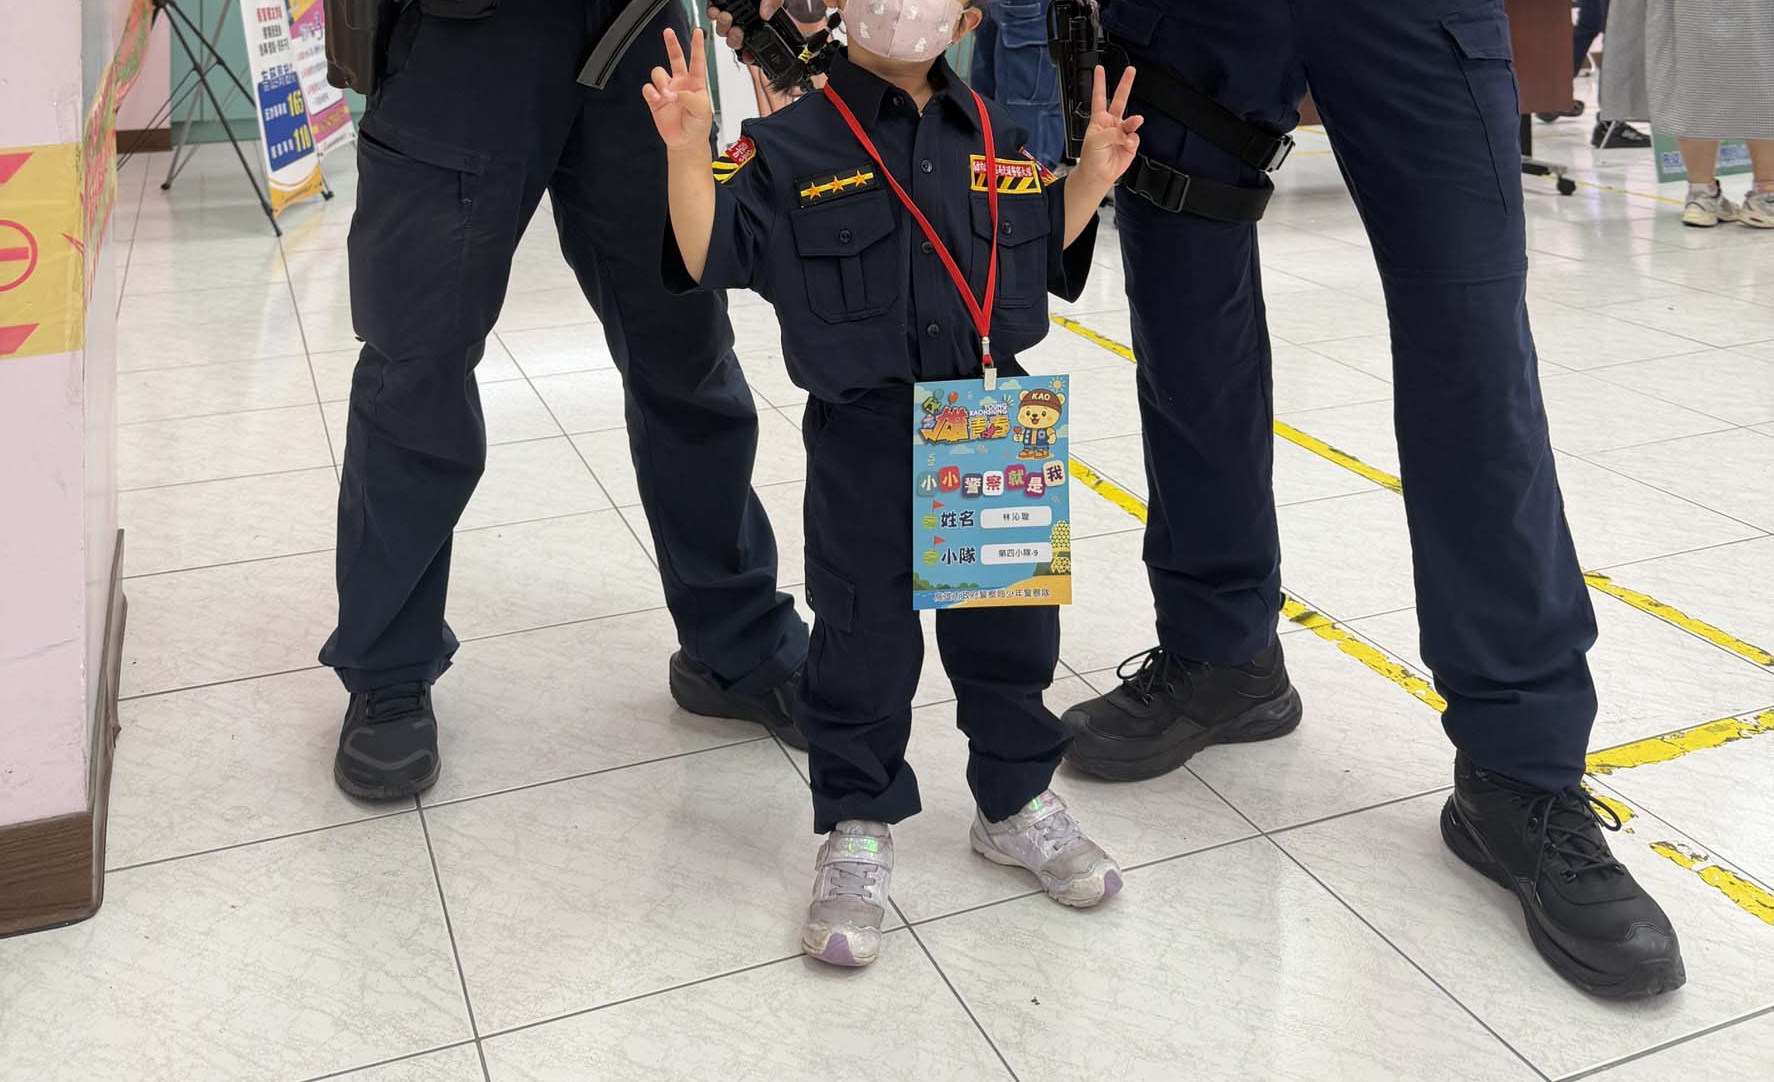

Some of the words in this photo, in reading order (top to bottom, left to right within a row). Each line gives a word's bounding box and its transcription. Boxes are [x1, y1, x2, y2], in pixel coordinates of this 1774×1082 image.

[287, 89, 305, 117] 165
[293, 124, 311, 153] 110
[1031, 392, 1050, 401] KAO
[920, 464, 1063, 494] 小小警察就是我
[940, 510, 975, 528] 姓名
[941, 547, 976, 565] 小隊
